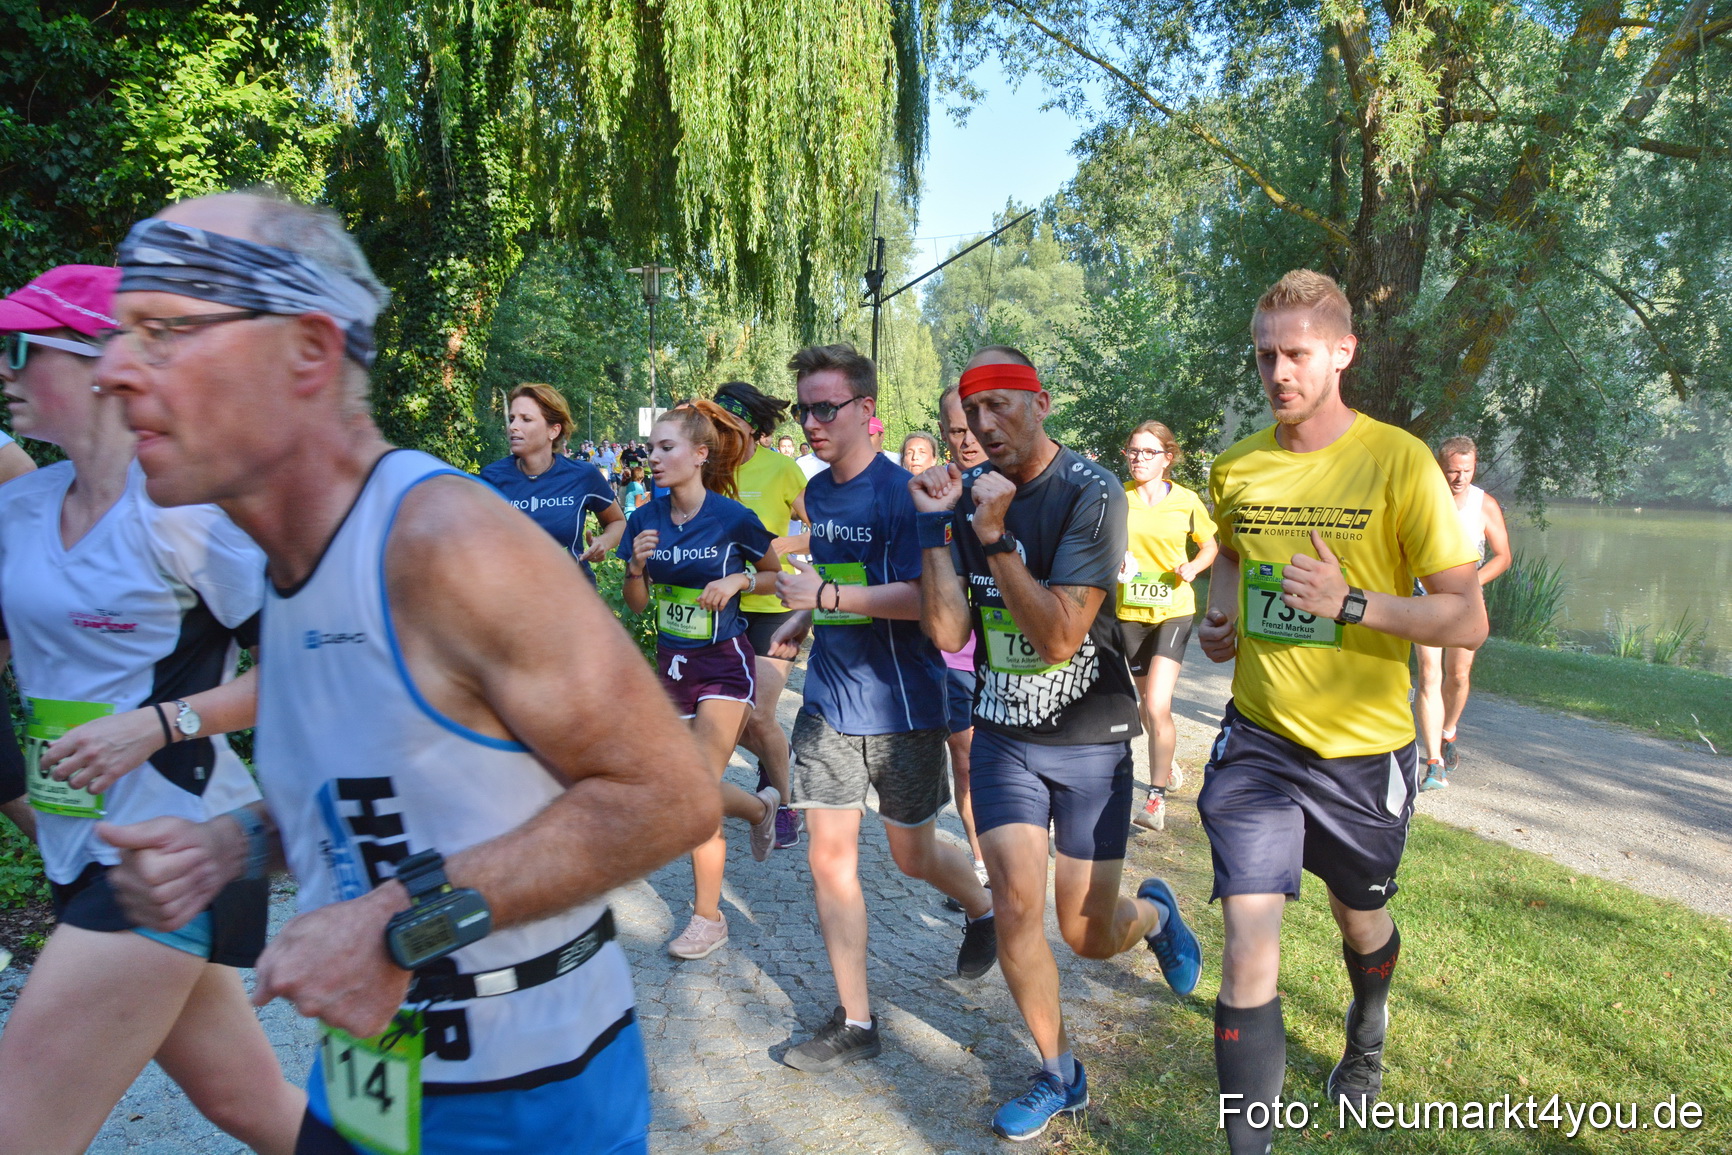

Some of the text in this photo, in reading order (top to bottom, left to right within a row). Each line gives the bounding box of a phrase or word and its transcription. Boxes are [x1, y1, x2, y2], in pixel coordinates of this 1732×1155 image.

[540, 495, 574, 508] POLES
[834, 525, 873, 543] POLES
[1264, 528, 1363, 541] KOMPETEN IM BÜRO
[648, 545, 718, 561] URO POLES
[1130, 583, 1169, 598] 1703
[666, 602, 696, 624] 497
[1261, 619, 1315, 634] Frenzl Markus
